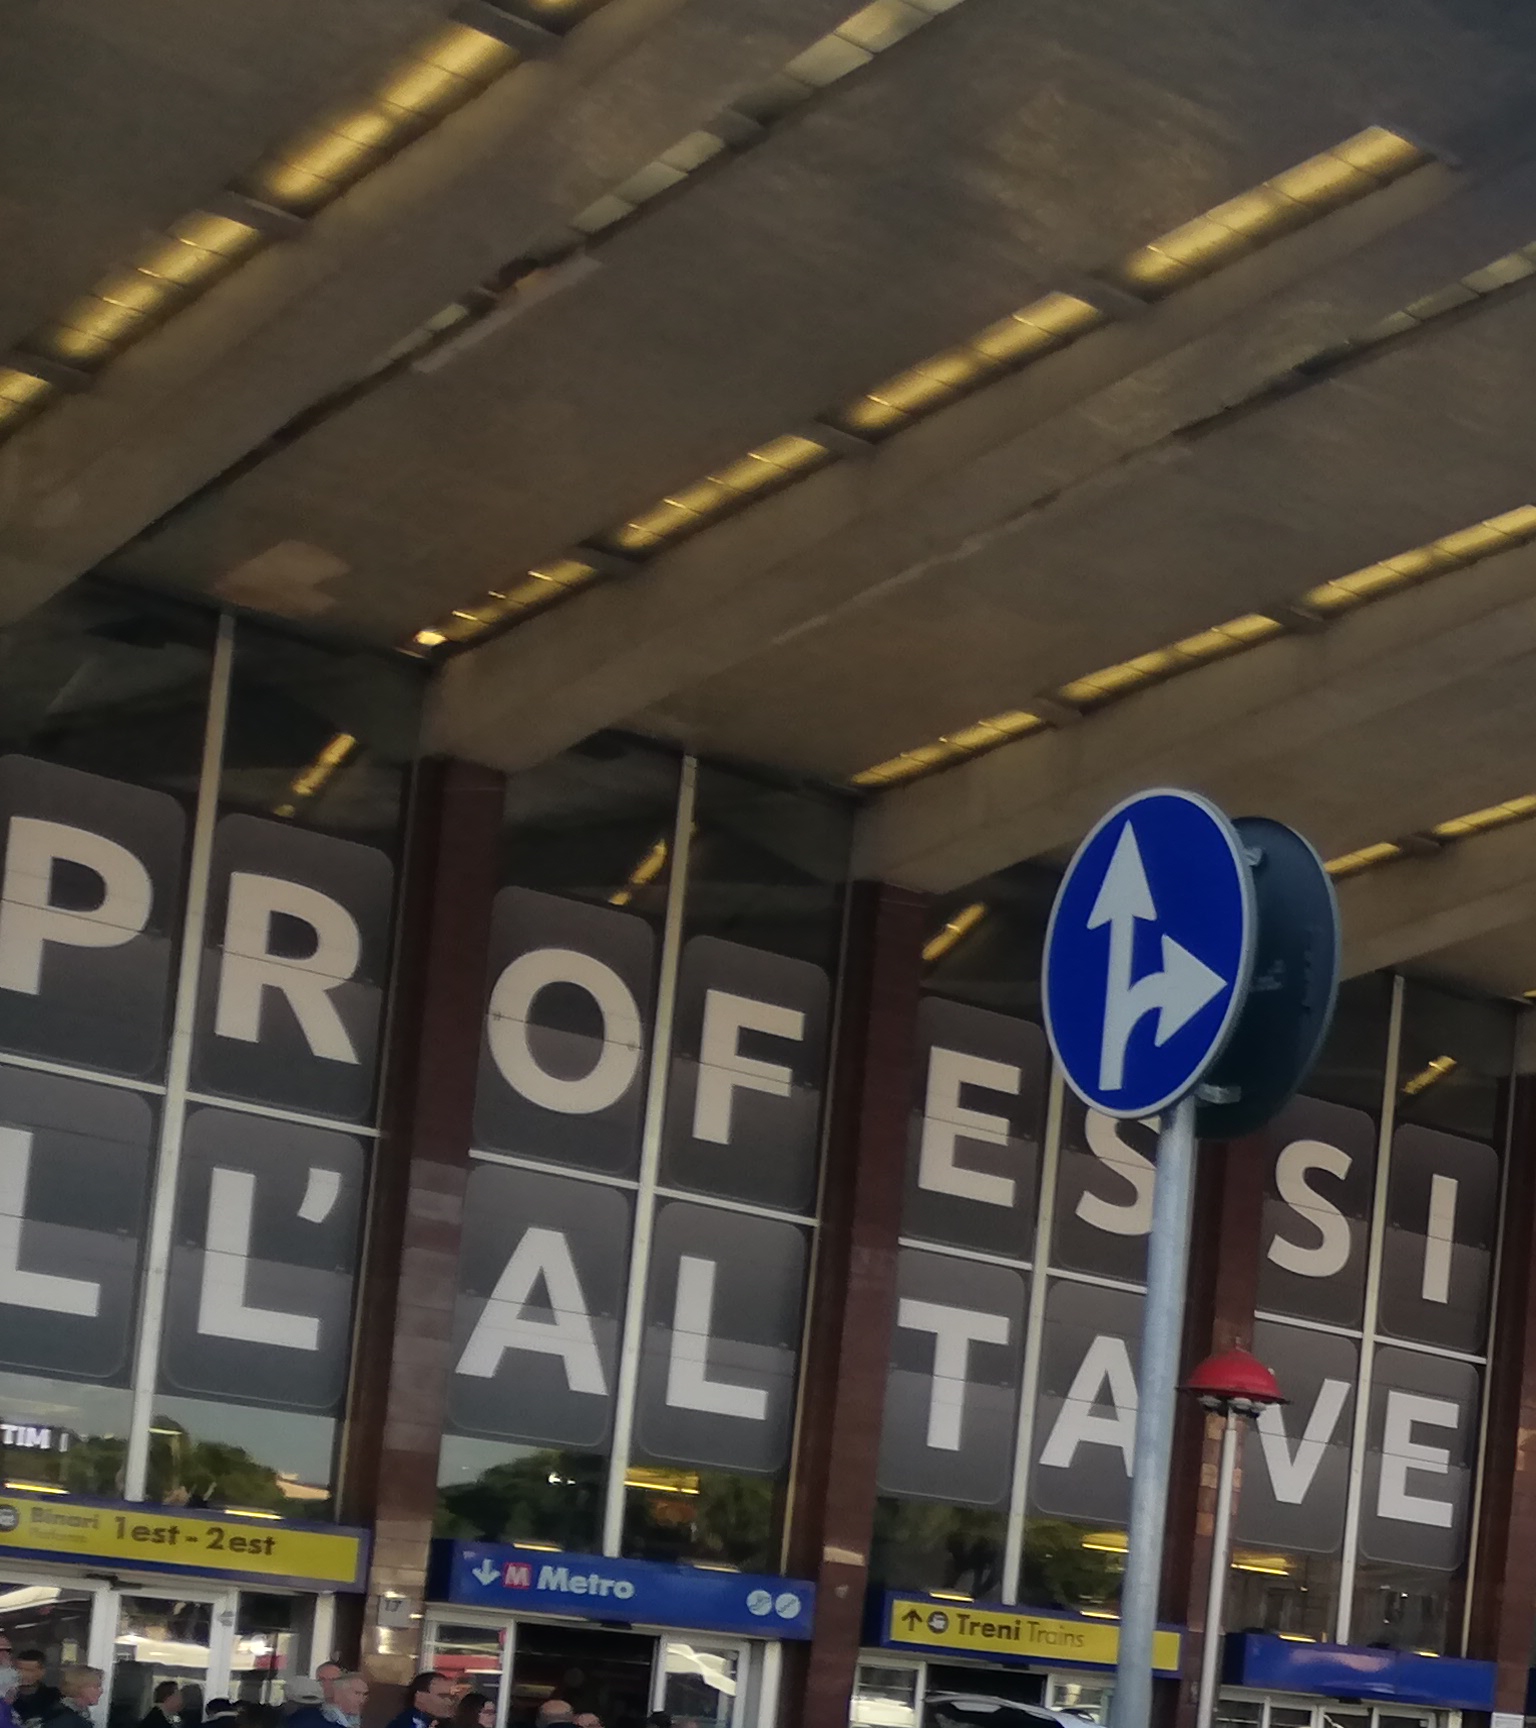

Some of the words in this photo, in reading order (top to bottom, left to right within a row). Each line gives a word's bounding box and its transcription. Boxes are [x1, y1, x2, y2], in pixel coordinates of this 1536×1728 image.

[114, 1516, 178, 1545] 1est
[205, 1527, 277, 1556] 2est
[536, 1565, 635, 1599] Metro
[956, 1613, 1021, 1641] Treni
[1028, 1621, 1085, 1647] Trains
